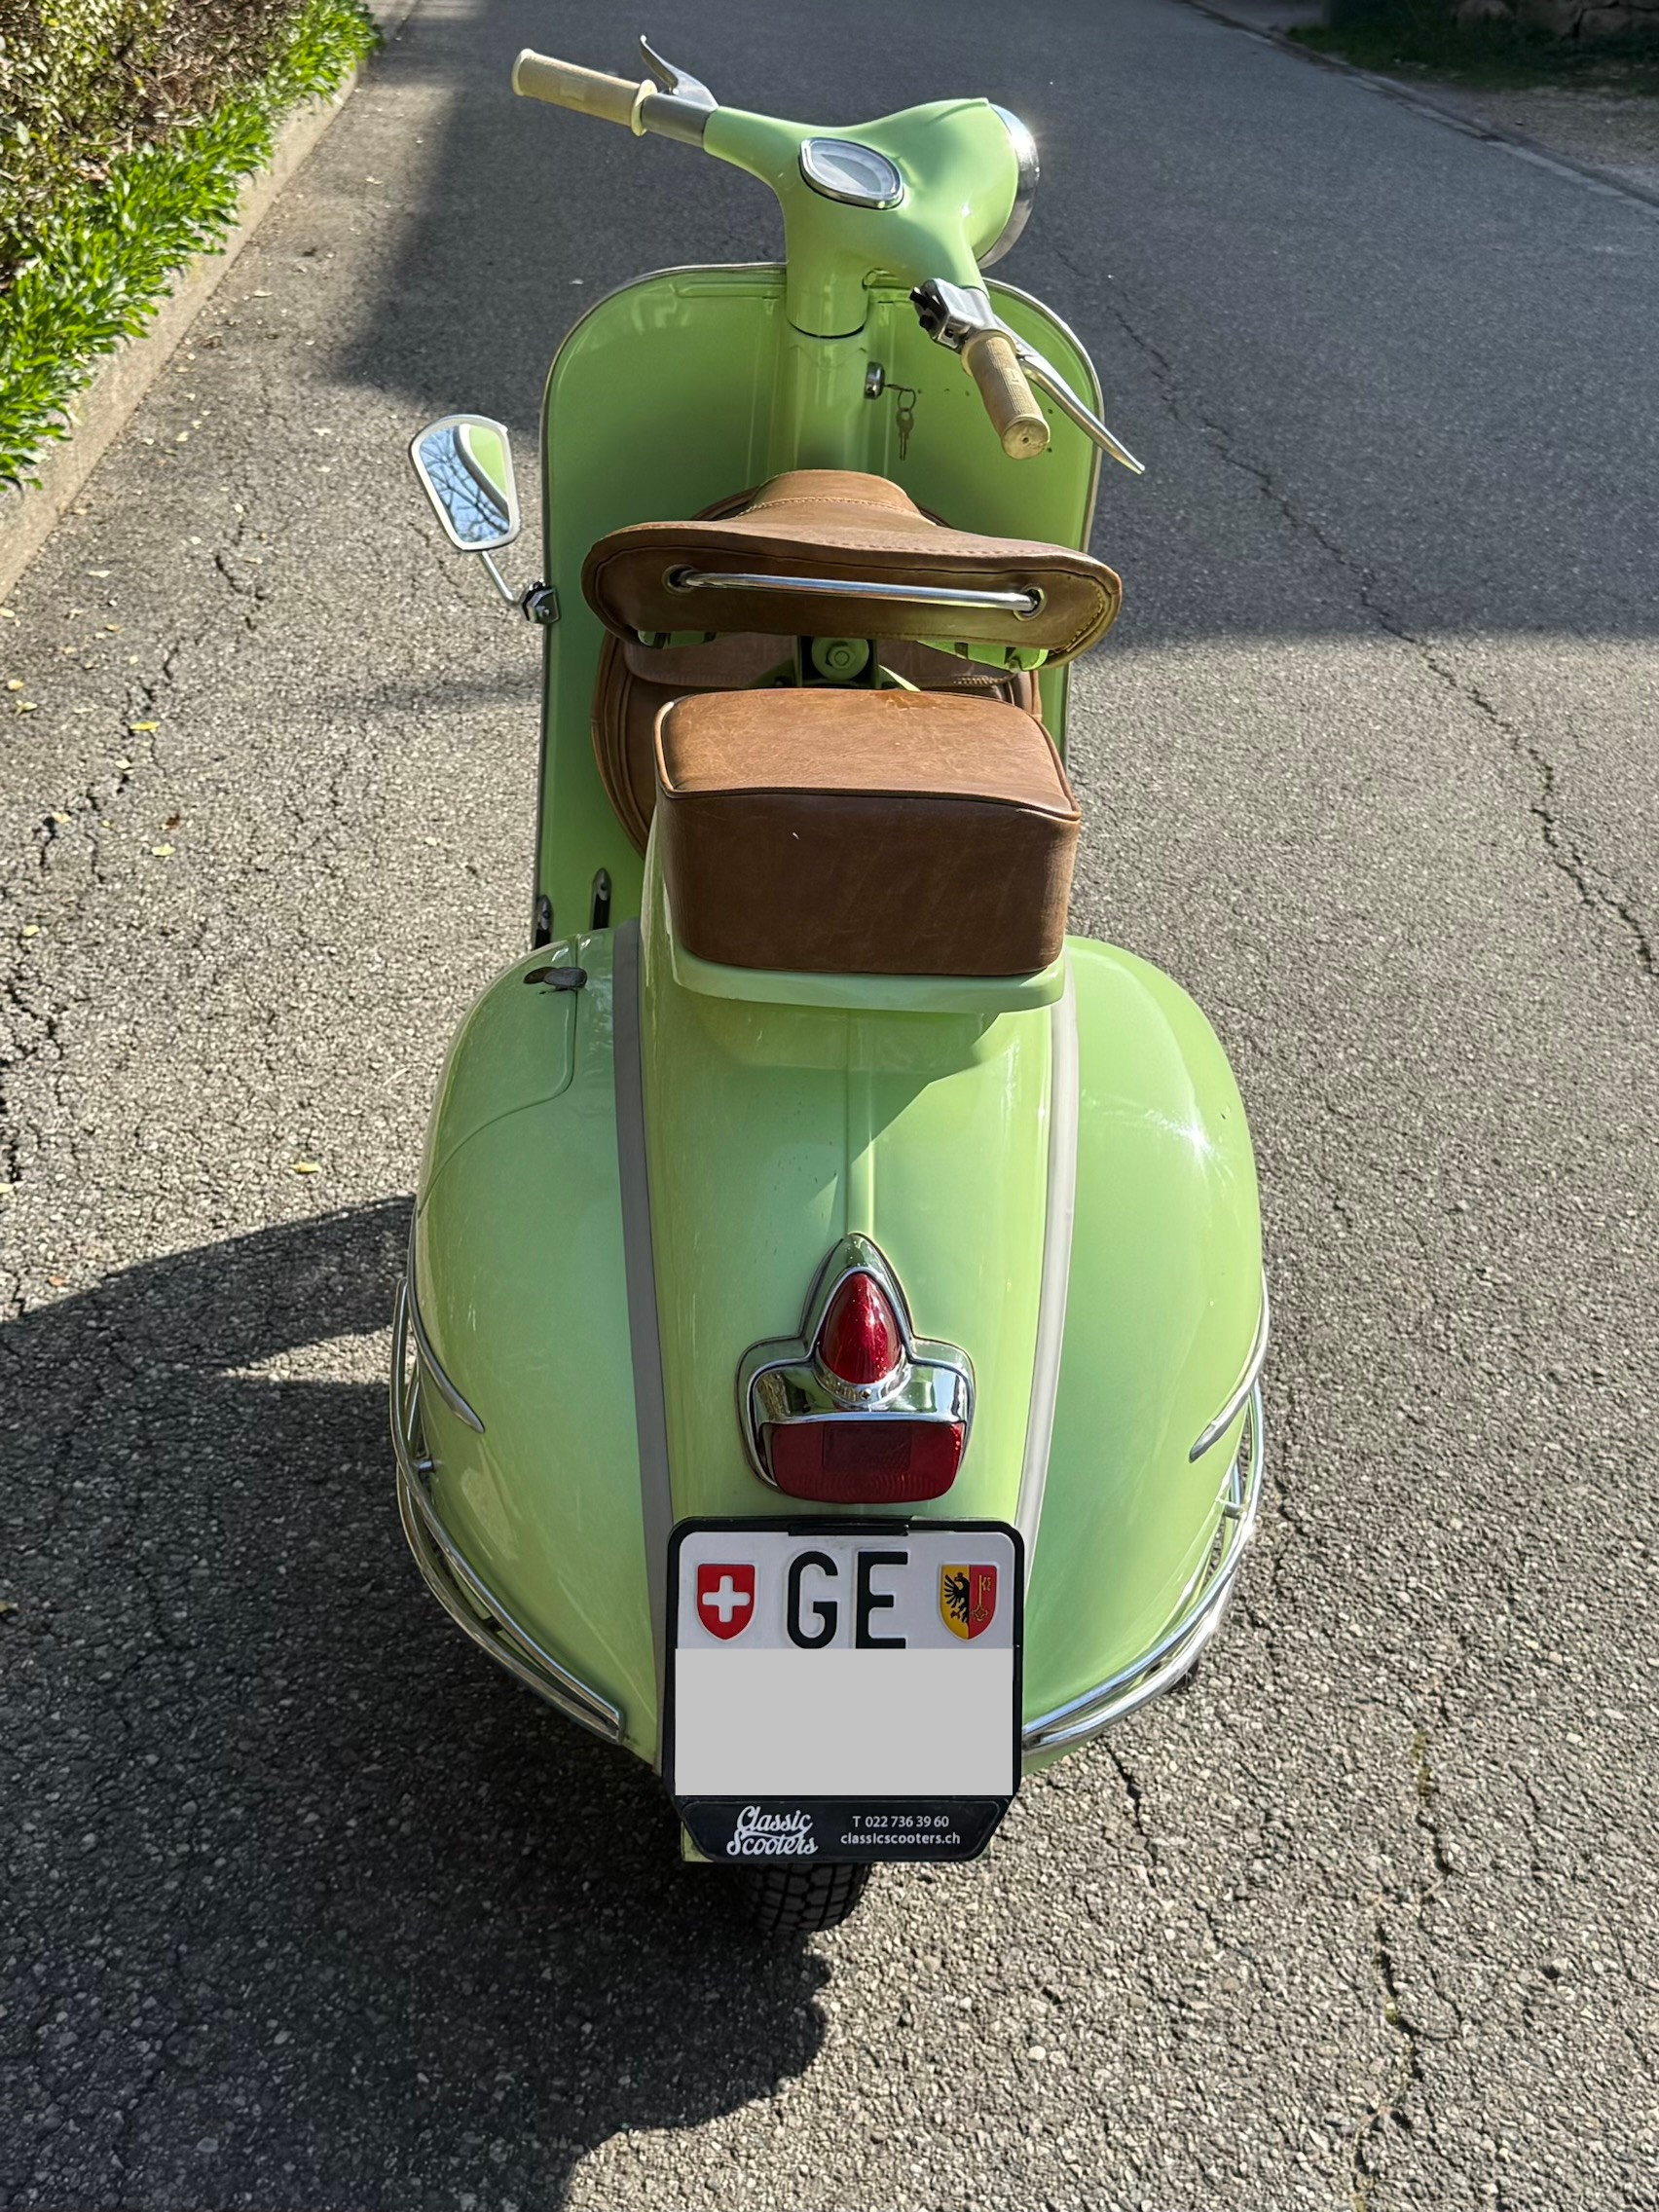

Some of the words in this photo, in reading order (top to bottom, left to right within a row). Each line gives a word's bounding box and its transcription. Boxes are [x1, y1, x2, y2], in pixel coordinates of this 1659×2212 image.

[787, 1551, 908, 1648] GE
[736, 1806, 813, 1832] Classic
[853, 1816, 861, 1827] T
[865, 1816, 888, 1827] 022
[891, 1816, 913, 1827] 736
[916, 1816, 932, 1827] 39
[934, 1816, 949, 1827] 60
[726, 1829, 818, 1856] Scooters
[840, 1831, 961, 1845] classicscooters.ch
